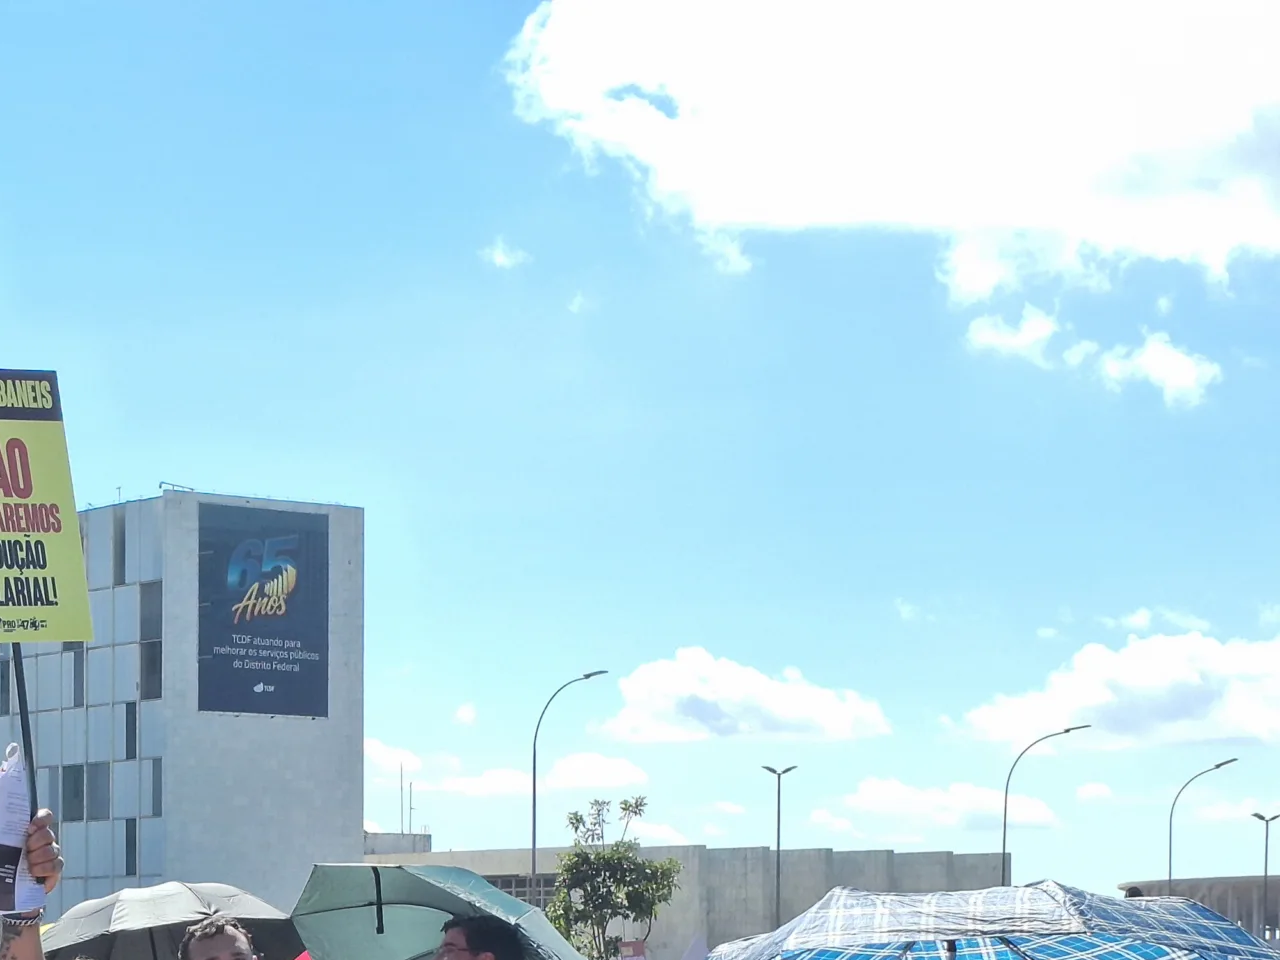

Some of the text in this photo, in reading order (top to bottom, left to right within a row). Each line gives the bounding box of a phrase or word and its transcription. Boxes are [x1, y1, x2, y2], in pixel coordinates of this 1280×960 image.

[227, 534, 299, 595] 65
[231, 582, 288, 624] Anos
[232, 634, 301, 649] TCDF atuando para
[213, 645, 319, 661] melhorar os serviços públicos
[233, 659, 300, 672] do Distrito Federal
